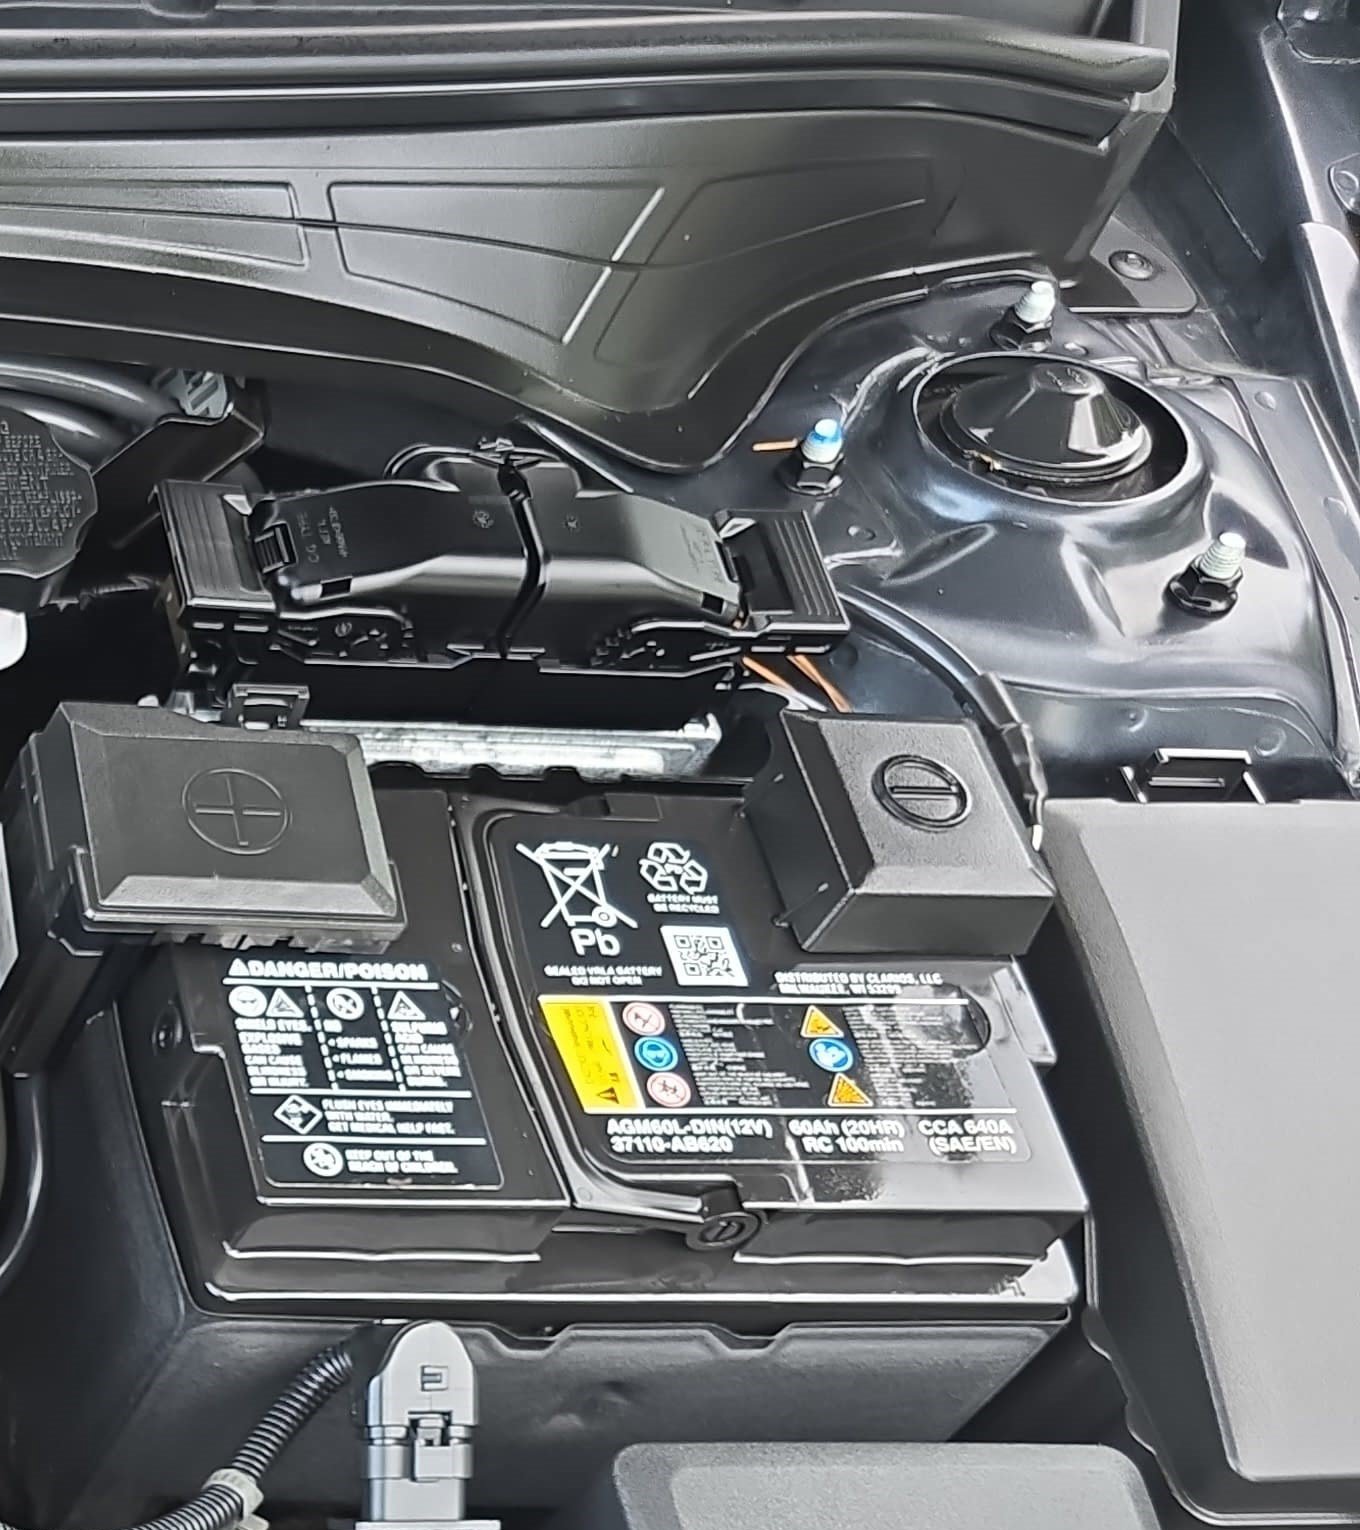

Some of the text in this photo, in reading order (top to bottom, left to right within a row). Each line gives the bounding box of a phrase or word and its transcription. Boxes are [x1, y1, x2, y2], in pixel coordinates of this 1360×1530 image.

[570, 928, 621, 956] Pb
[788, 1119, 839, 1137] 60Ah
[841, 1119, 906, 1138] (20HR)
[918, 1119, 962, 1136] CCA
[964, 1119, 1014, 1136] 640A
[610, 1136, 1017, 1156] 37110-AB620 RC 100min (SAE/EN)
